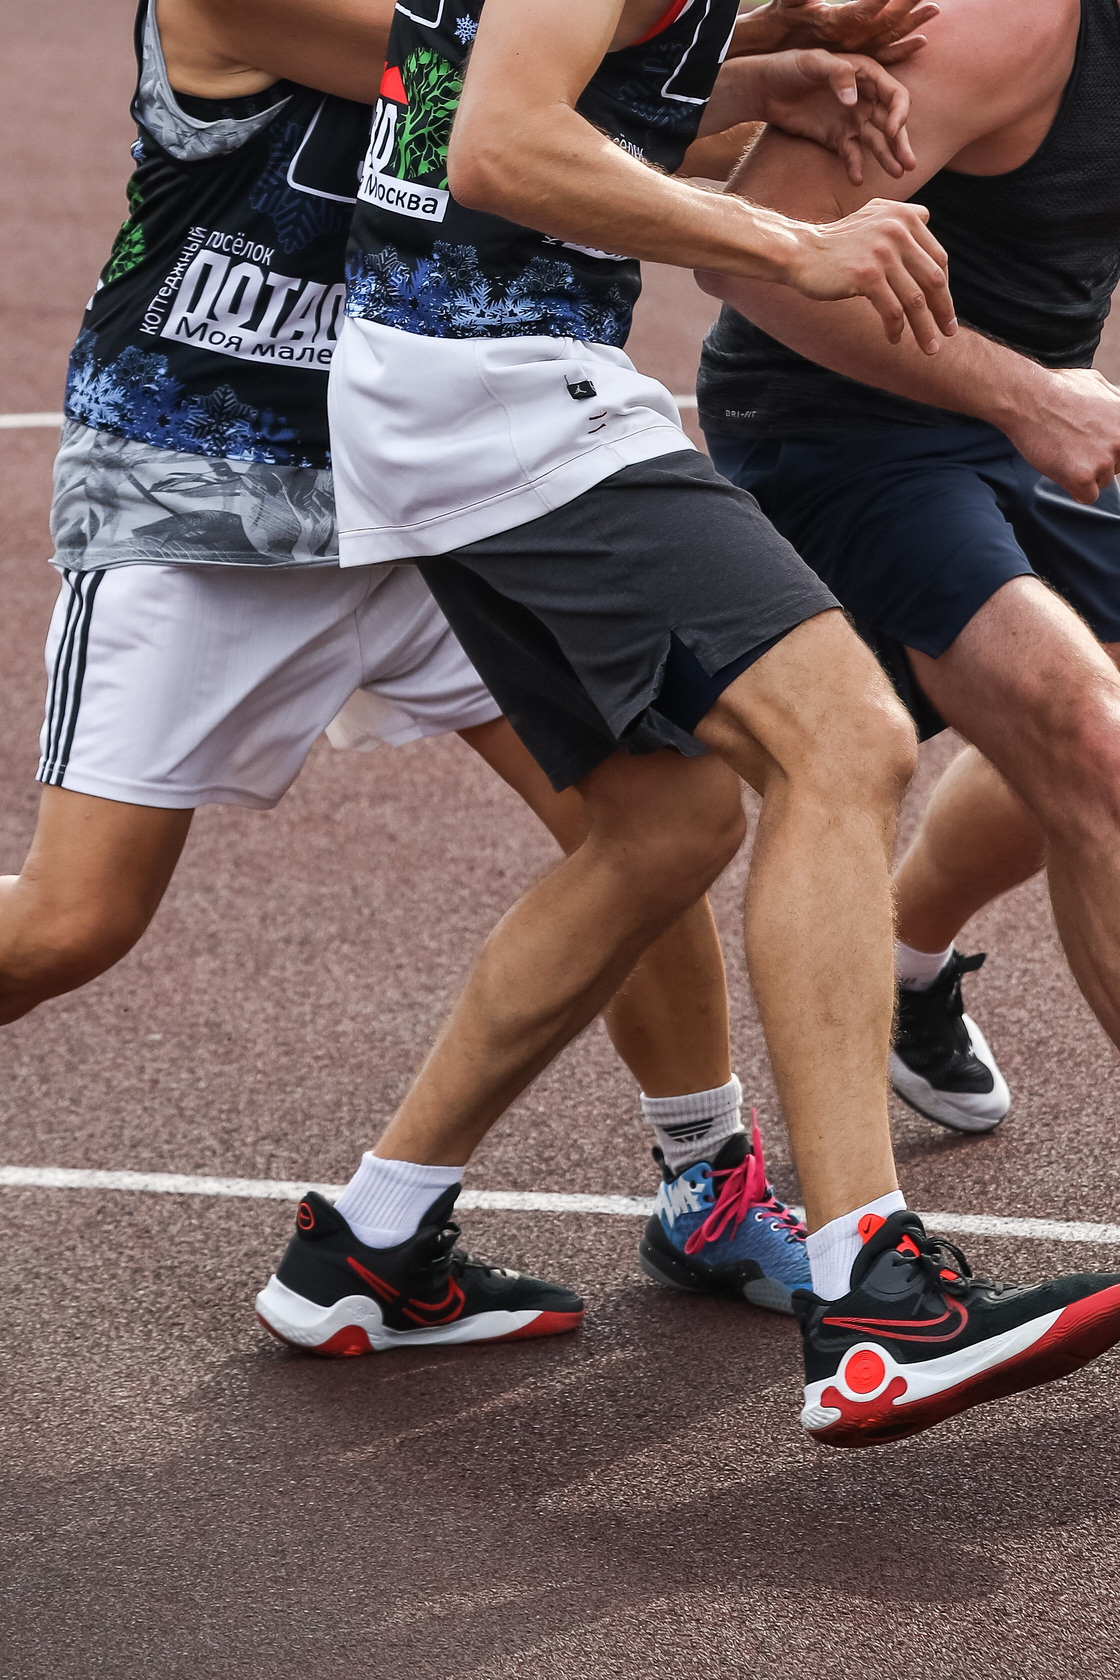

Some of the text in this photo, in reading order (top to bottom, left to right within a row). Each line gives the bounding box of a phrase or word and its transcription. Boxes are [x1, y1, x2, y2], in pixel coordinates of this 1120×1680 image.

[364, 174, 440, 215] Москва
[139, 226, 207, 335] коттеджный
[175, 316, 243, 352] Моя
[725, 409, 757, 418] DRI-FIT
